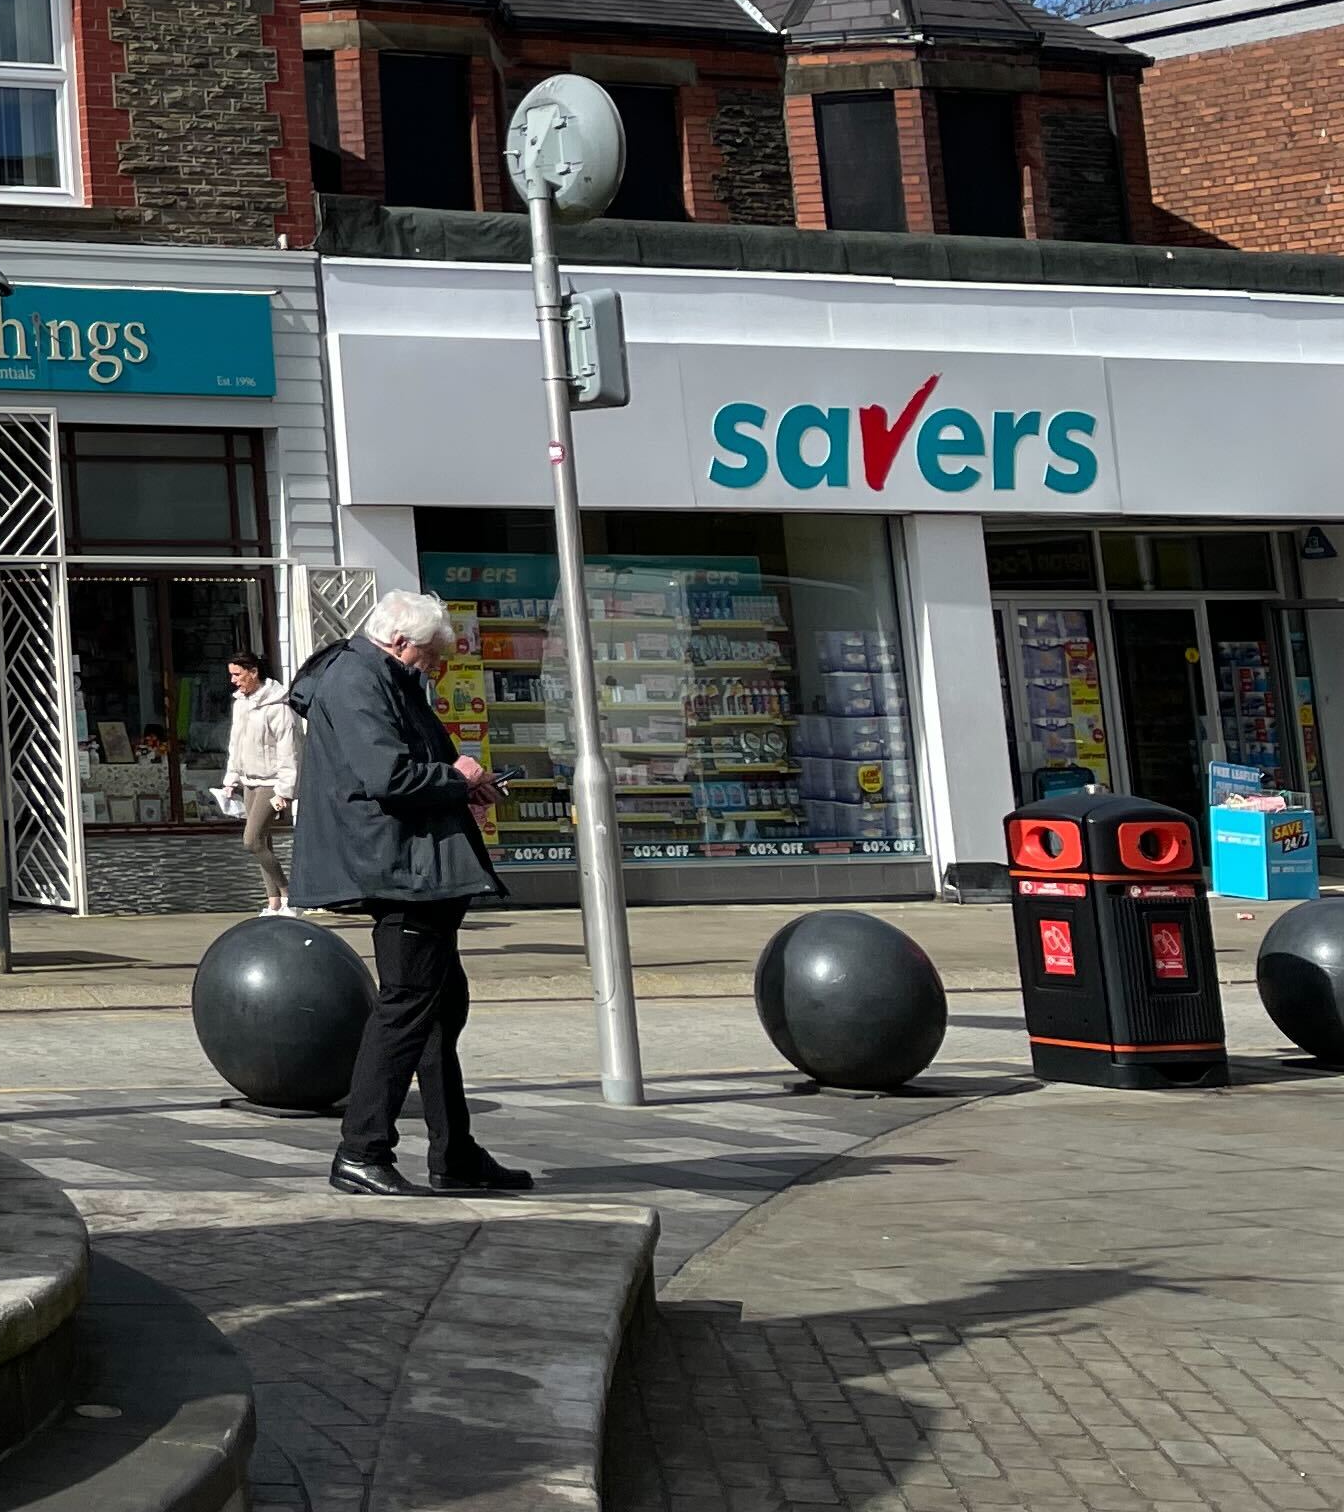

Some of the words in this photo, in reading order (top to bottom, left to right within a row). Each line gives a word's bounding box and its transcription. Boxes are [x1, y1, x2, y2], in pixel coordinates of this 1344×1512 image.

[709, 373, 1099, 494] savers
[1274, 820, 1302, 840] SAVE
[862, 840, 891, 852] 60%
[894, 840, 916, 852] OFF
[1284, 832, 1308, 851] 24/7
[514, 847, 545, 860] 60%
[548, 847, 572, 860] OFF
[633, 844, 662, 857] 60%
[666, 844, 689, 857] OFF
[749, 843, 778, 855] 60%
[781, 842, 804, 855] OFF
